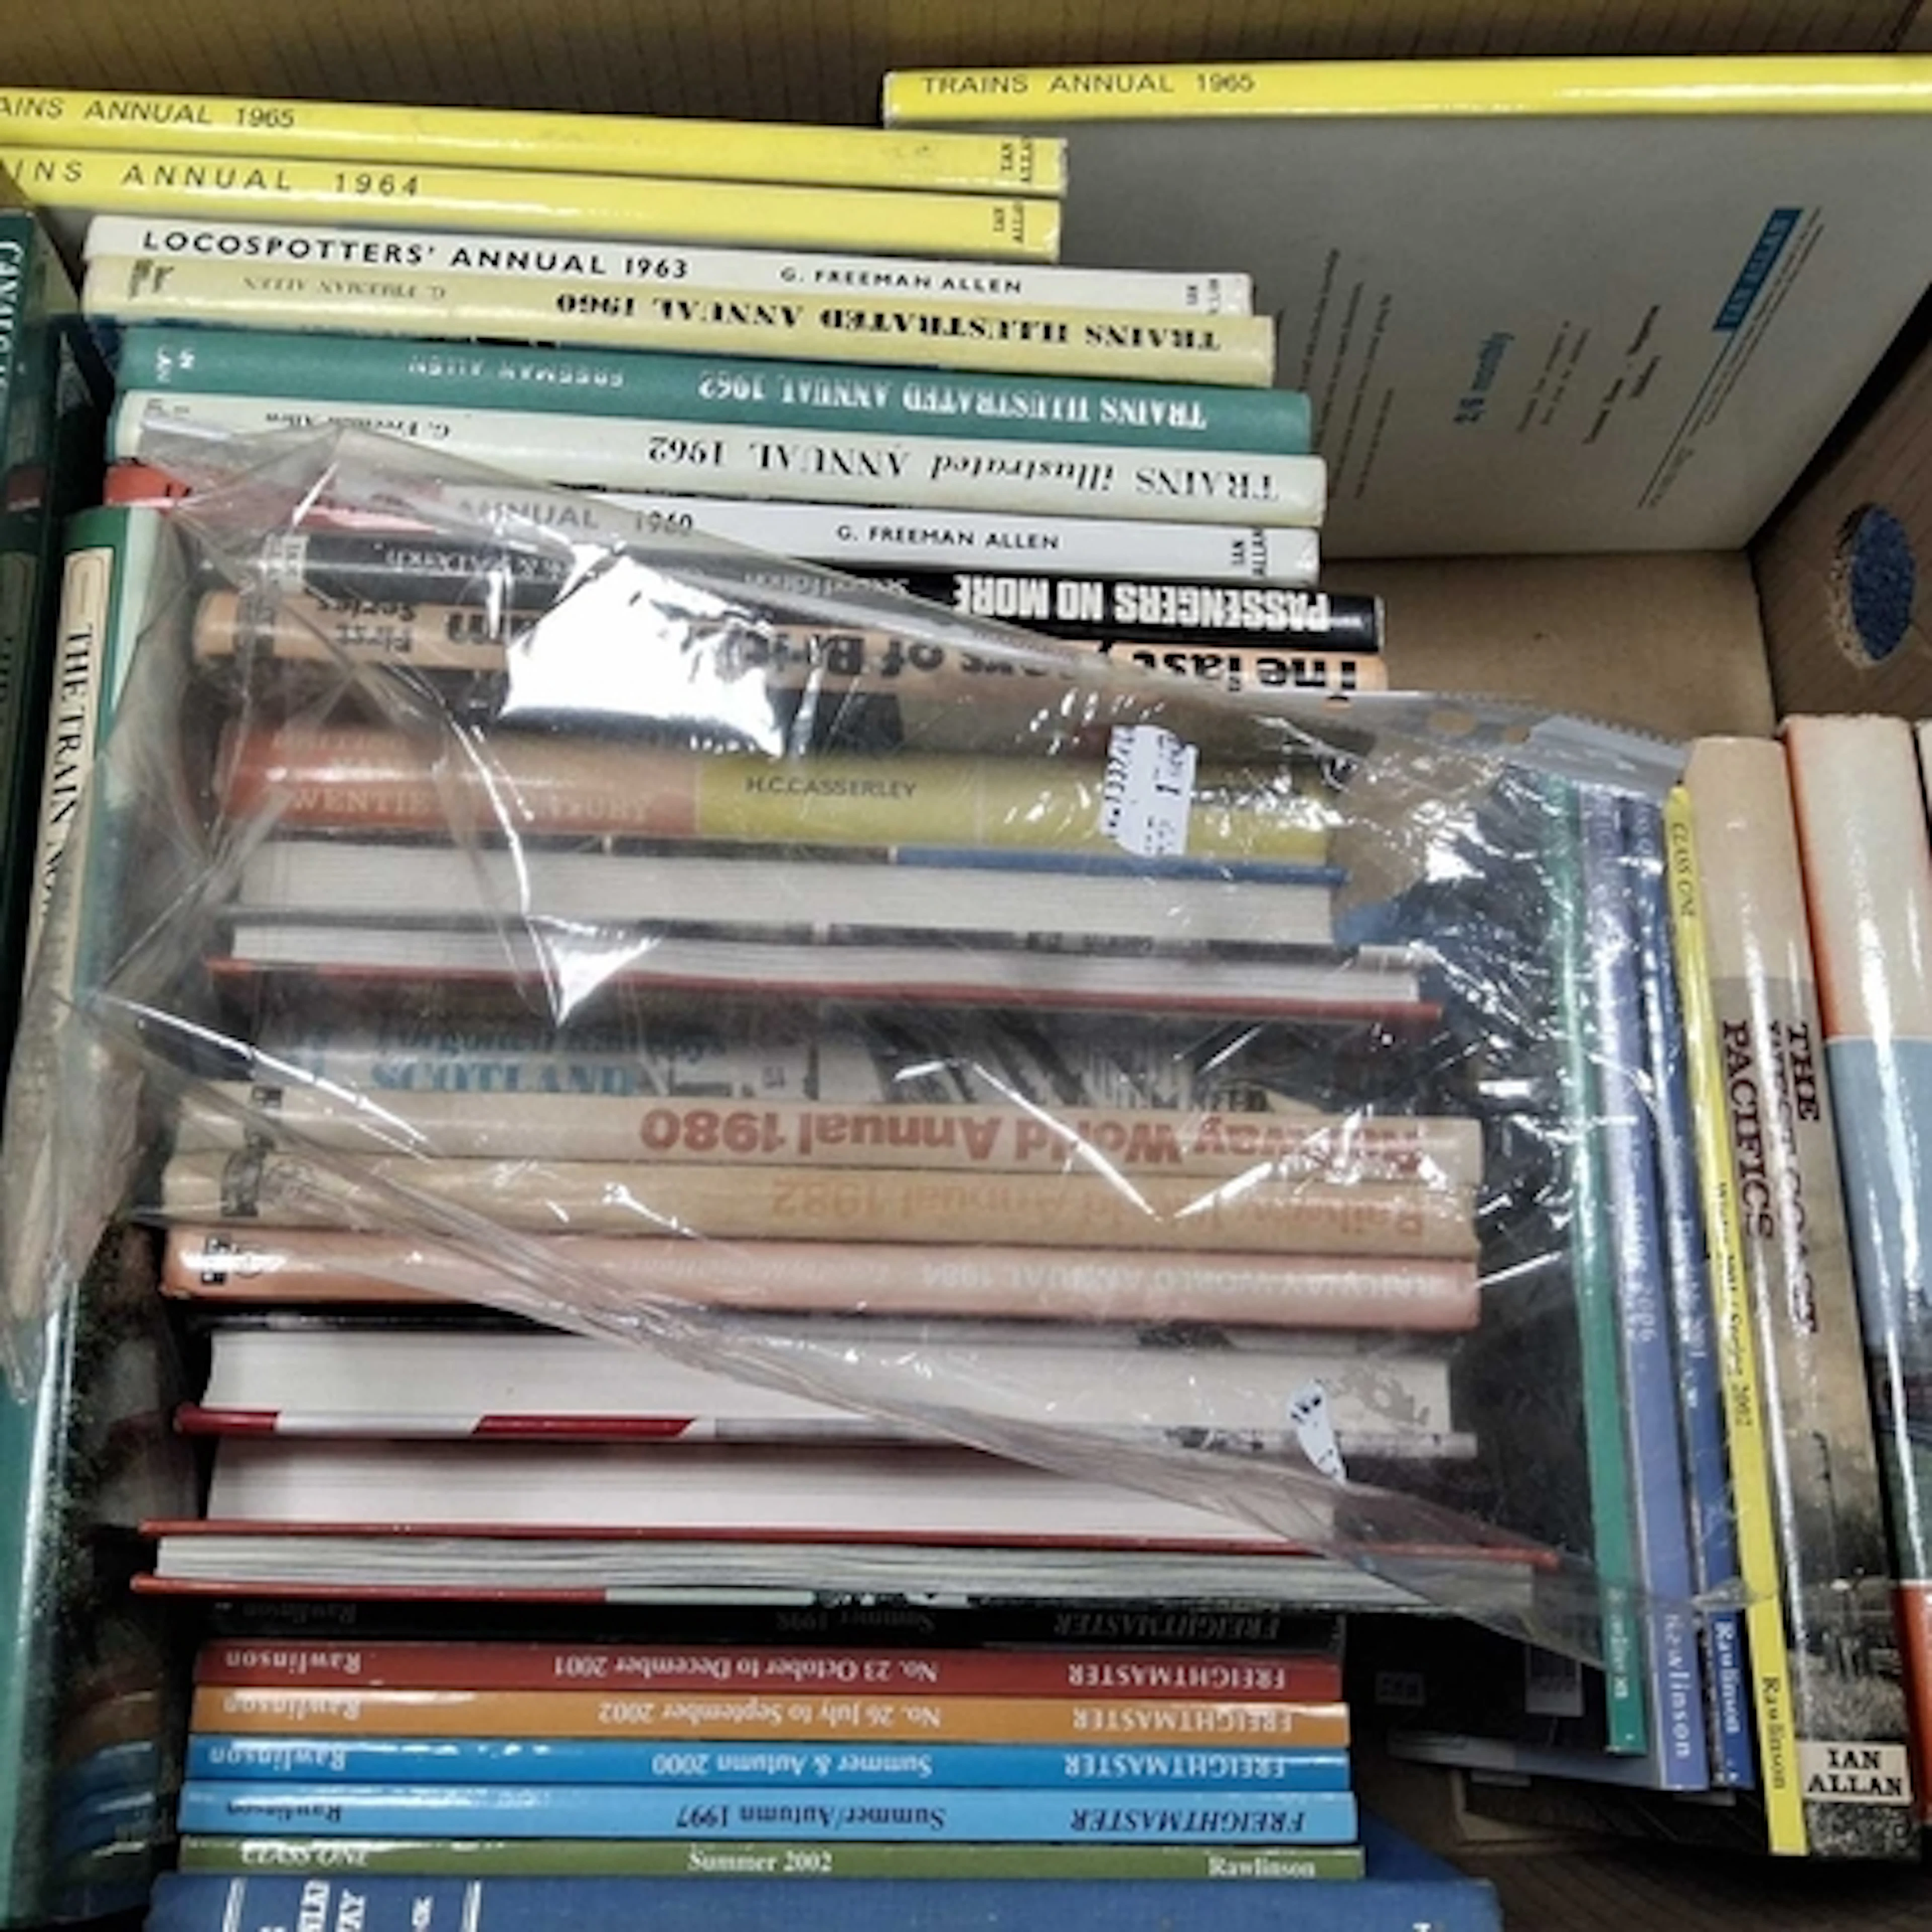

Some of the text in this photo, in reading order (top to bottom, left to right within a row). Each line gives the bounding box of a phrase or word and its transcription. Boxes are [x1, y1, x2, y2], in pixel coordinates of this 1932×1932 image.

[923, 73, 1256, 95] TRAINS ANNUAL 1965
[85, 100, 212, 125] ANNUAL
[236, 107, 295, 128] 1965
[122, 165, 292, 192] ANNUAL
[335, 173, 419, 196] 1964
[142, 230, 688, 279] LOCOSPOTTERS' ANNUAL 1963
[780, 267, 1022, 294] G. FREEMAN ALLEN
[555, 293, 1221, 352] TRAINS ILLUSTRATED ANNUAL 1960
[781, 376, 889, 408] ANNUAL
[903, 384, 1091, 423] ILLUSTRATED
[1100, 399, 1206, 429] TRAINS
[649, 436, 1279, 502] TRAINS illustrated ANNUAL 1962
[837, 526, 1059, 551] G. FREEMAN ALLEN
[953, 574, 1331, 632] PASSENGERS NO MORE
[61, 623, 93, 703] THE
[51, 706, 86, 825] TRAIN
[371, 1060, 639, 1095] SCOTLAND
[1787, 1023, 1820, 1122] THE
[639, 1108, 787, 1151] 1980
[798, 1112, 992, 1161] Annual
[1015, 1118, 1184, 1163] World
[1723, 1019, 1774, 1240] PACIFICS
[1055, 1613, 1280, 1639] FREIGHTMASTER
[225, 1651, 1286, 1689] FREIGHTMASTER No. 23 October to December 2001 Rawlinson
[1663, 1613, 1693, 1758] Rawlinson
[599, 1702, 655, 1724] 2002
[662, 1698, 782, 1727] September
[788, 1703, 812, 1723] to
[821, 1701, 861, 1727] July
[866, 1705, 894, 1726] 26
[903, 1708, 941, 1728] No.
[1072, 1707, 1293, 1733] FREIGHTMASTER
[652, 1752, 710, 1775] 2000
[716, 1752, 810, 1776] Autumn
[815, 1754, 831, 1777] &
[838, 1753, 934, 1778] Summer
[1064, 1752, 1286, 1780] FREIGHTMASTER
[1827, 1747, 1881, 1770] IAN
[1806, 1777, 1902, 1797] ALLAN
[676, 1804, 729, 1828] 1997
[740, 1804, 946, 1832] Summer/Autumn
[1070, 1808, 1307, 1834] FREIGHTMASTER
[686, 1848, 777, 1874] Summer
[782, 1849, 833, 1874] 2002
[1208, 1856, 1316, 1879] Rawlinson
